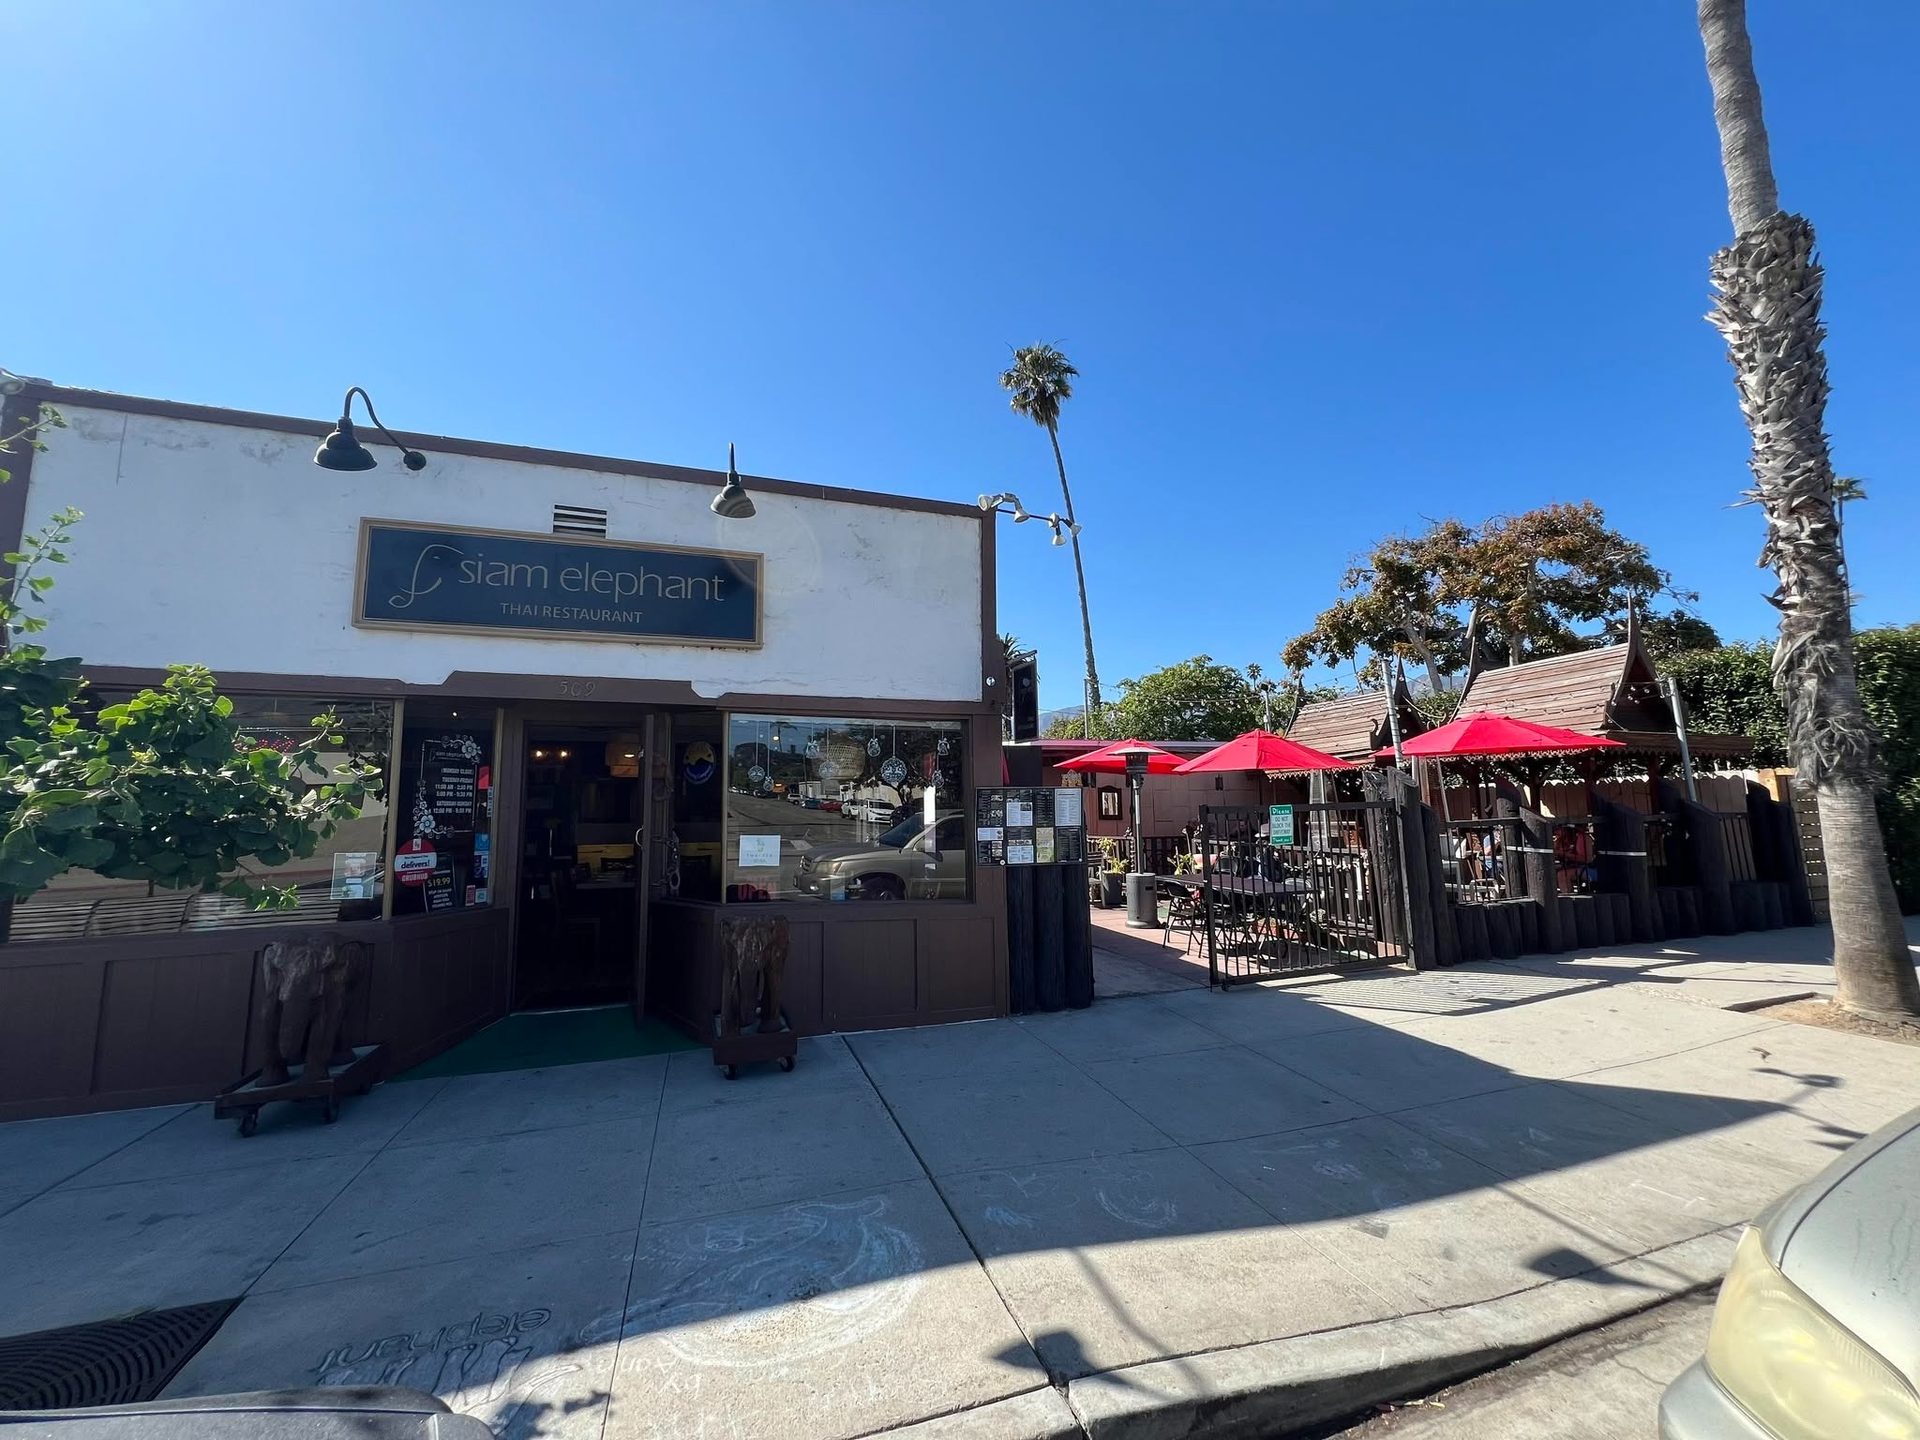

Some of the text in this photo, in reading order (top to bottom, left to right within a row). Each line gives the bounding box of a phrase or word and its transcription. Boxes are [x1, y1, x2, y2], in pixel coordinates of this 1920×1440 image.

[457, 552, 725, 603] siam elephant
[500, 602, 643, 624] THAI RESTAURANT
[401, 859, 430, 869] delivers!
